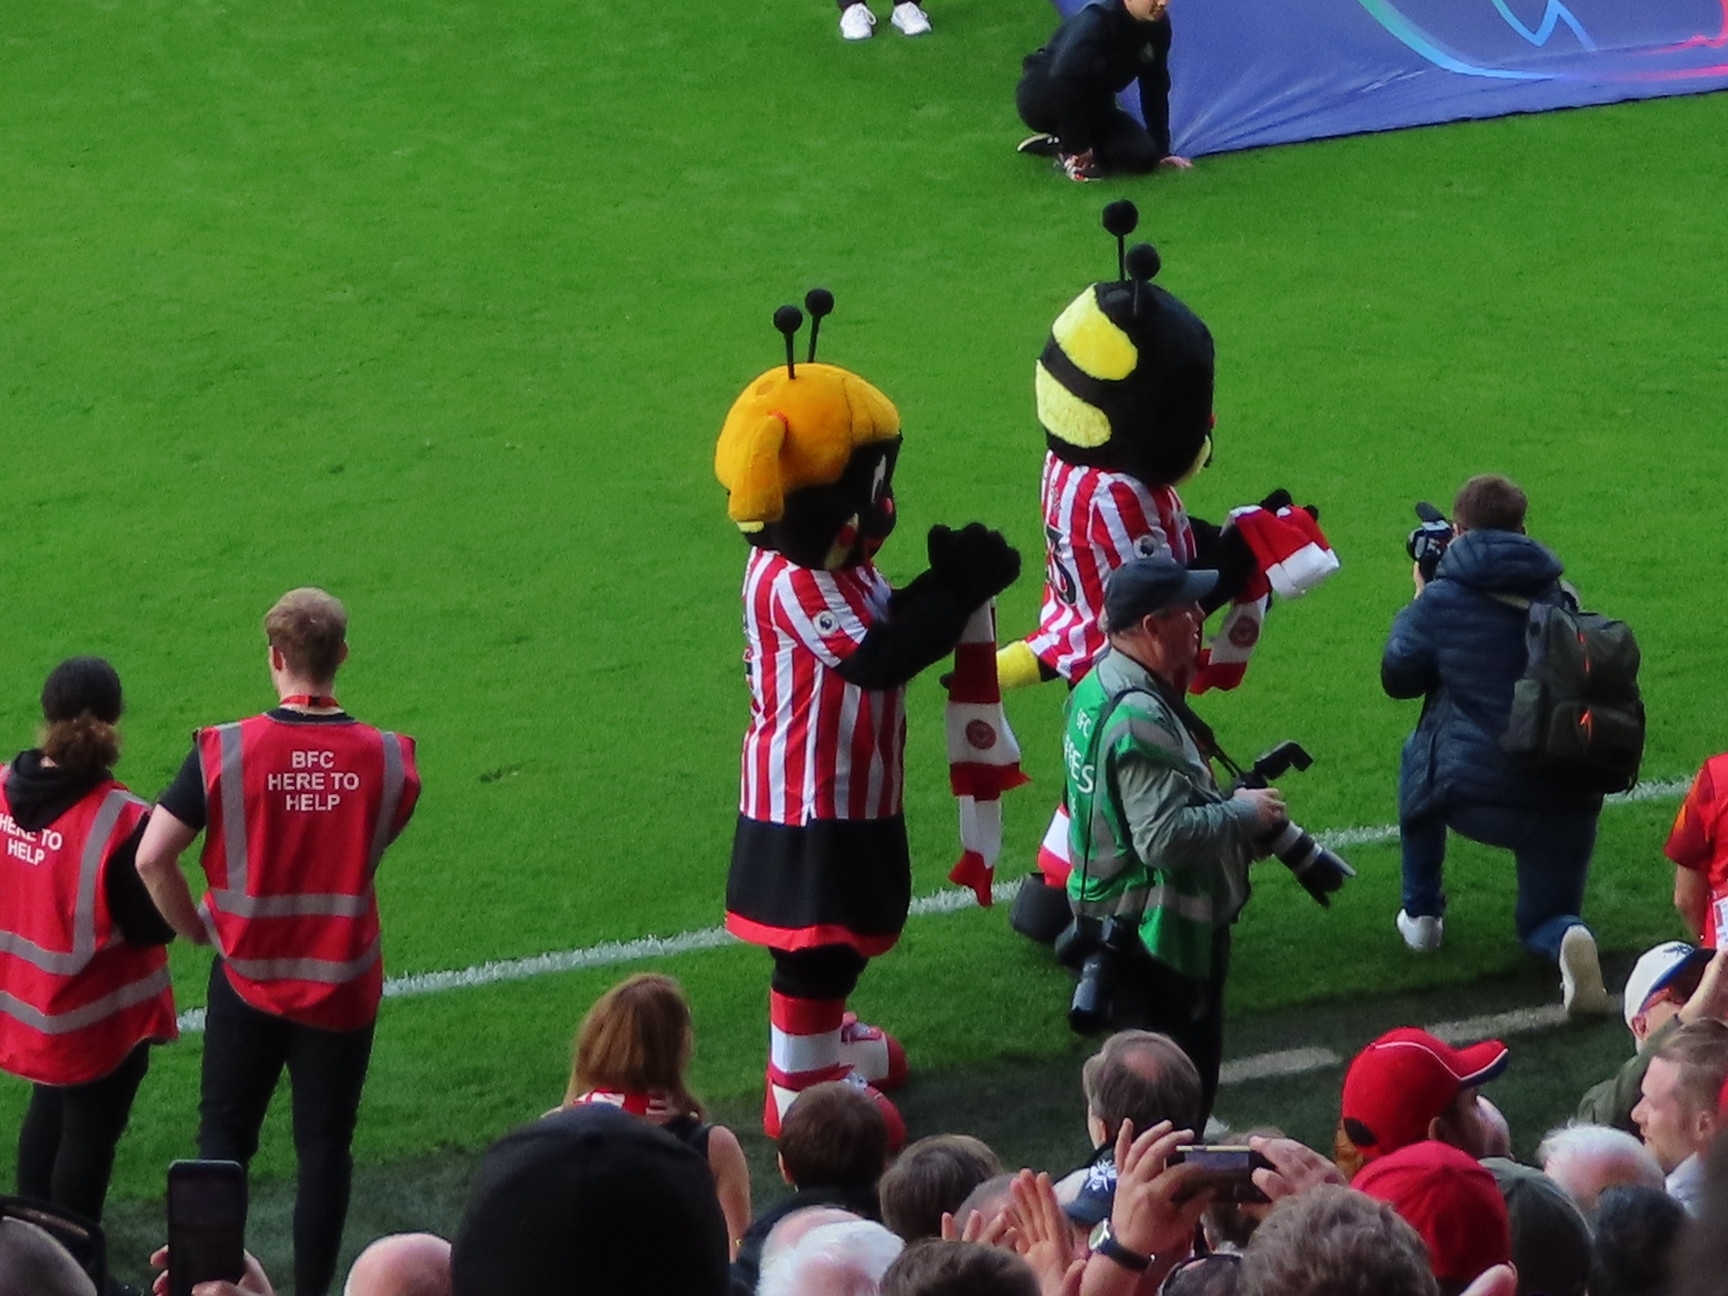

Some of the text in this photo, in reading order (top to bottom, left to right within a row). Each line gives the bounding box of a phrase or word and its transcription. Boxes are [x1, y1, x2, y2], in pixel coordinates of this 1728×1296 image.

[291, 751, 334, 769] BFC
[268, 772, 360, 791] HERE TO
[285, 794, 341, 811] HELP
[41, 828, 63, 851] TO
[7, 838, 46, 866] HELP
